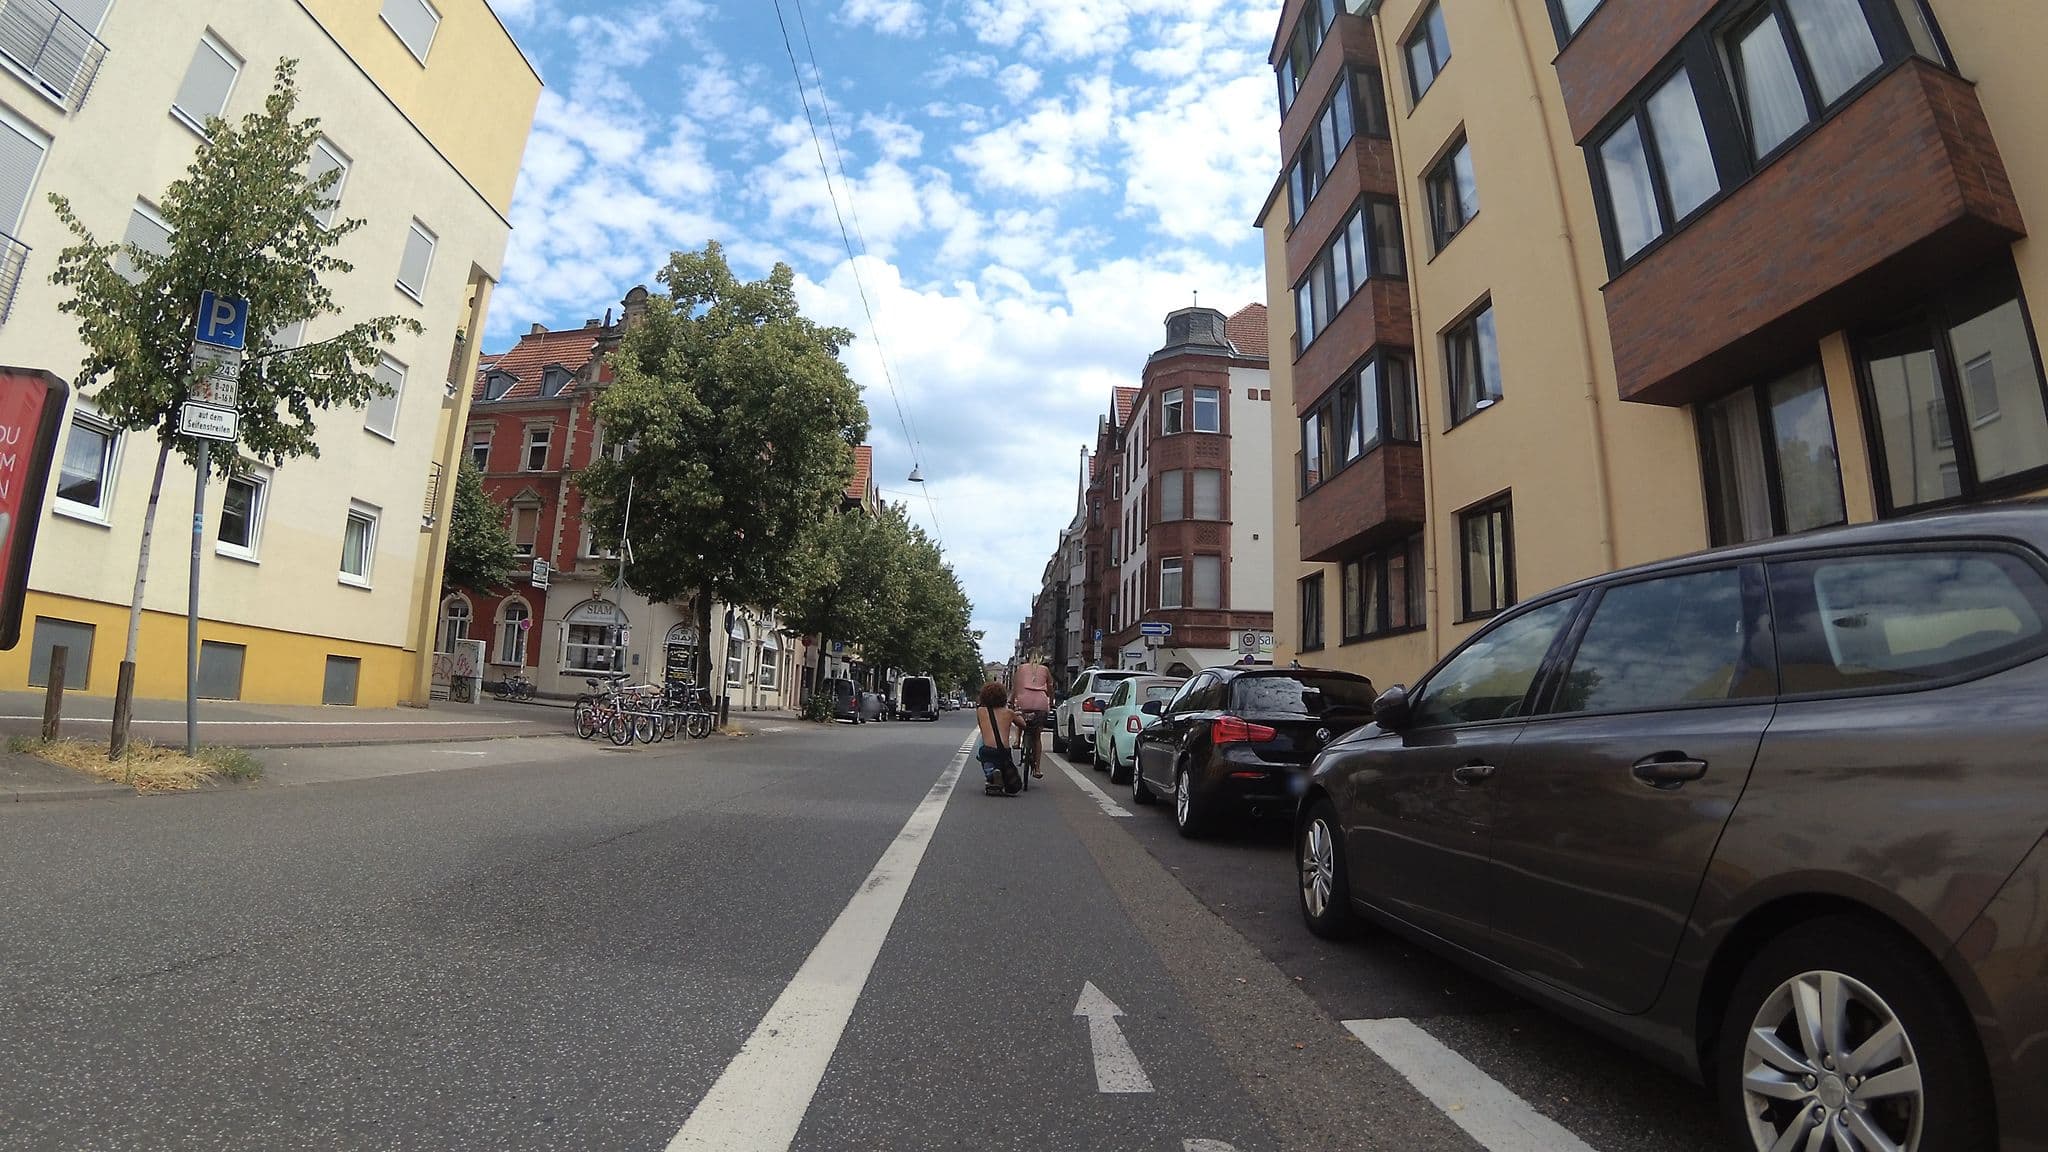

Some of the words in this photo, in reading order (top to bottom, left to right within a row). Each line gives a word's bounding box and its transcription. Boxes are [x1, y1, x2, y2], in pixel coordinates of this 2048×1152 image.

[208, 299, 236, 337] P
[198, 412, 209, 420] auf
[209, 413, 223, 422] dem
[187, 418, 231, 434] Seitenstreifen
[587, 604, 612, 615] SIAM
